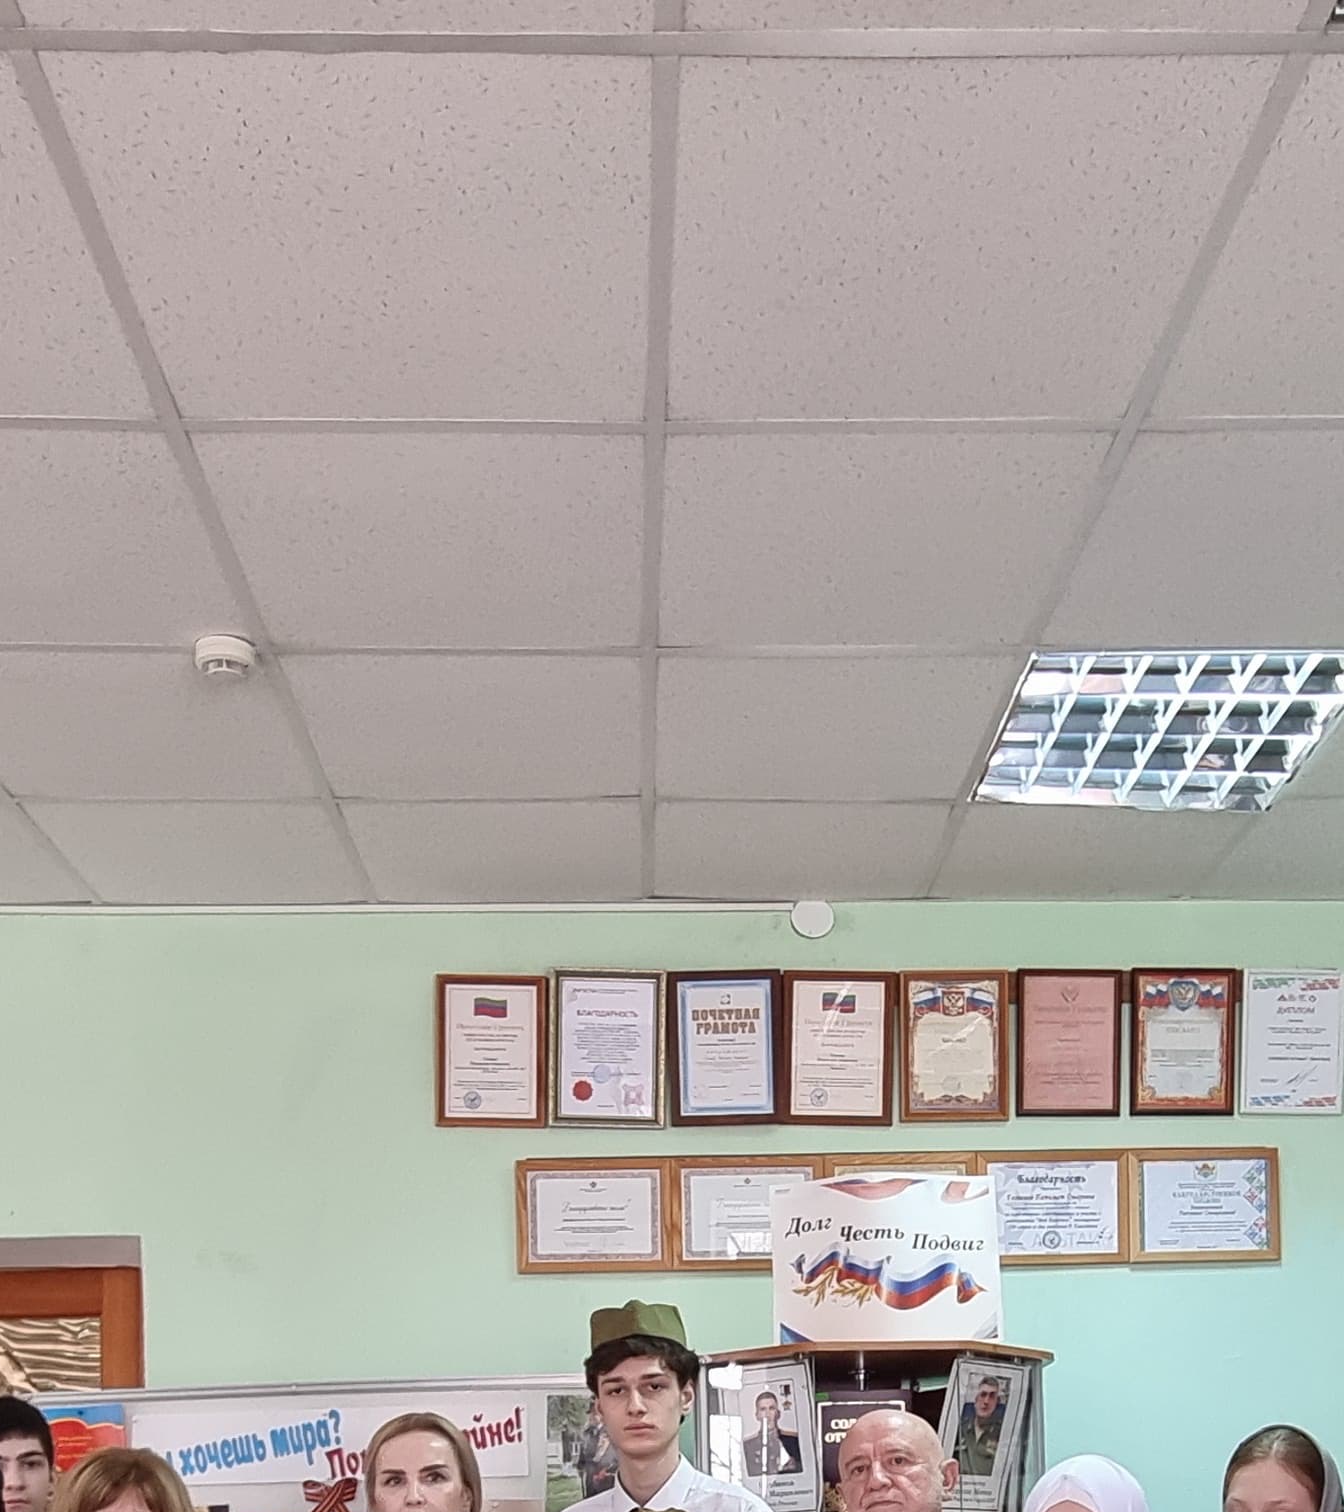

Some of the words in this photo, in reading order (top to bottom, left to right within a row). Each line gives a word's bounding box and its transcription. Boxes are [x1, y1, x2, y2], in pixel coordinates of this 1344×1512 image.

[696, 1022, 756, 1035] ГРАМОТА
[785, 1216, 832, 1238] Долг
[840, 1225, 905, 1242] Честь
[912, 1233, 985, 1251] Подвиг
[179, 1433, 266, 1476] хочешь
[269, 1409, 341, 1466] мира?
